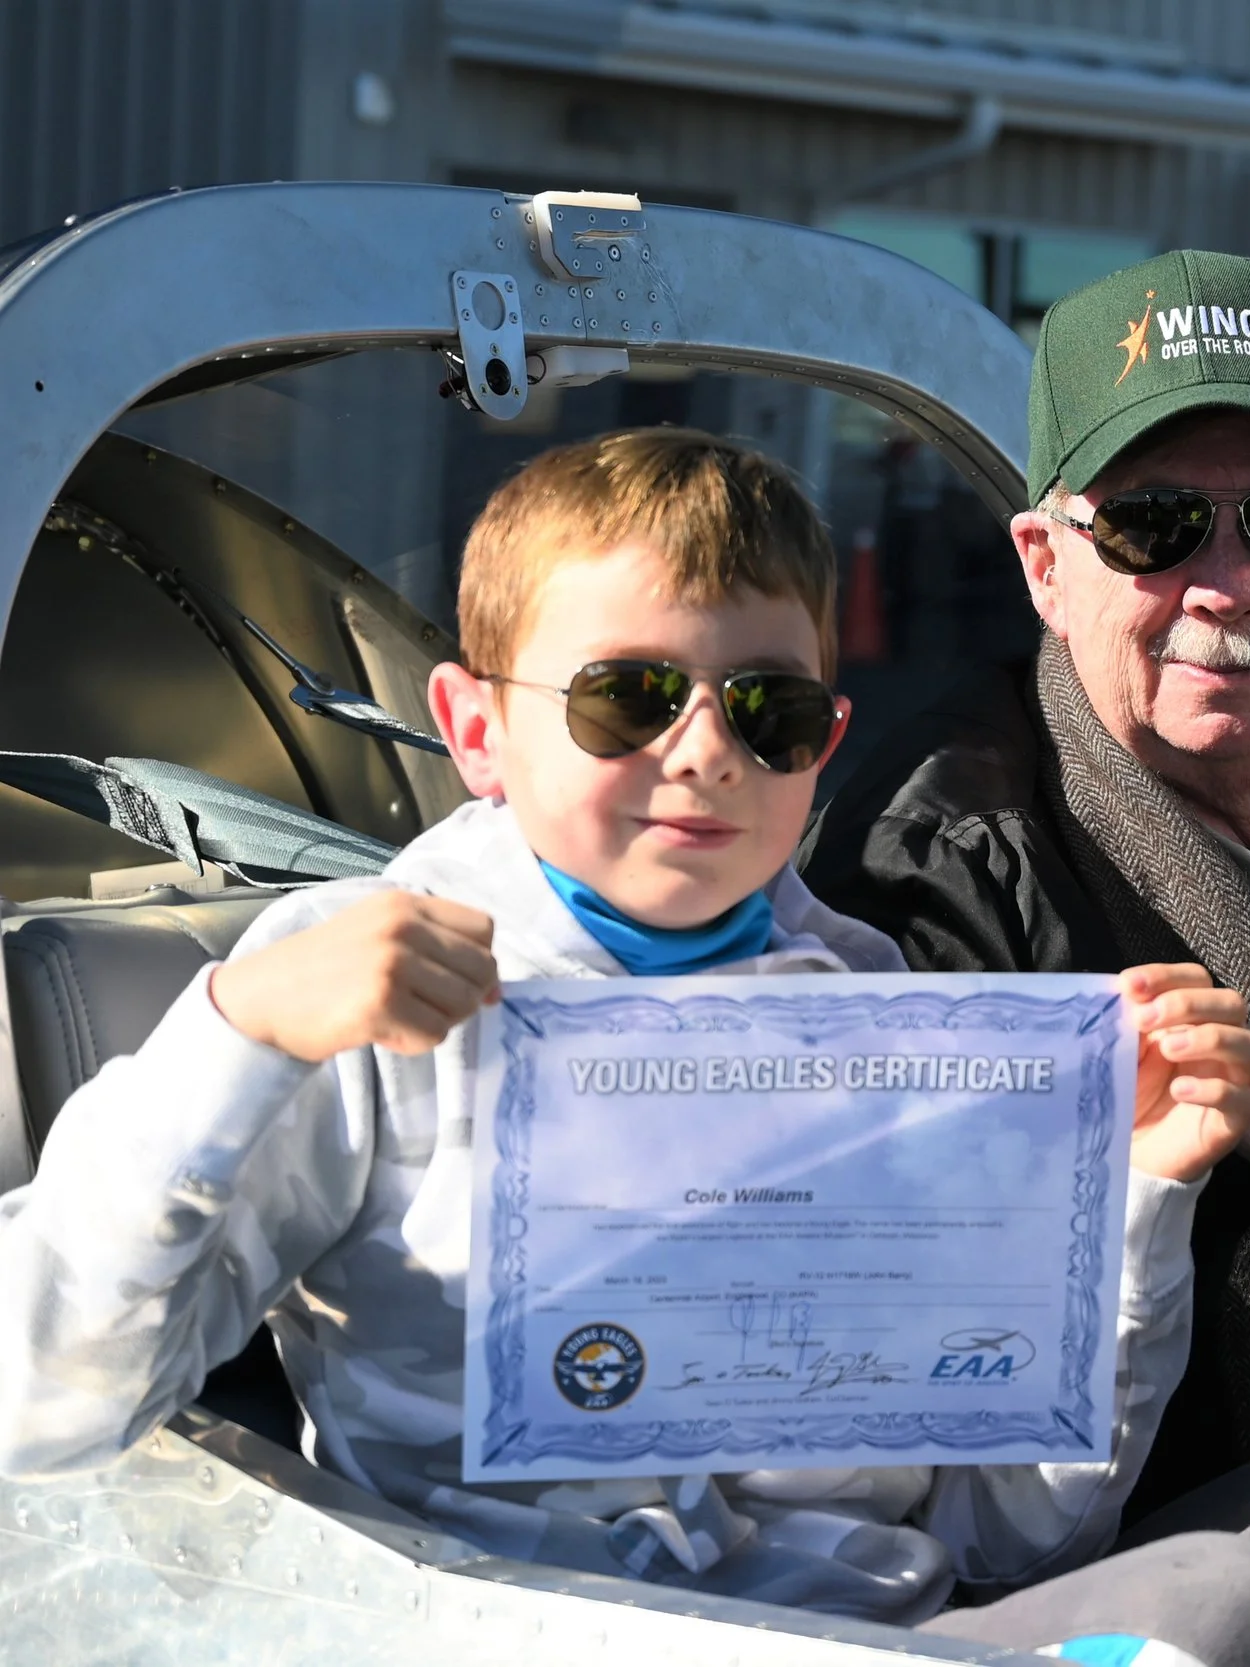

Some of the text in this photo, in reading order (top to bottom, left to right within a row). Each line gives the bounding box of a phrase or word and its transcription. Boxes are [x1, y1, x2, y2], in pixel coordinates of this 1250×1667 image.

[1161, 341, 1198, 360] OVER
[1203, 337, 1232, 354] THE
[569, 1054, 1055, 1095] YOUNG EAGLES CERTIFICATE
[684, 1187, 815, 1205] Cole Williams
[562, 1327, 638, 1358] YOUNG EAGLES
[930, 1355, 1014, 1378] EAA
